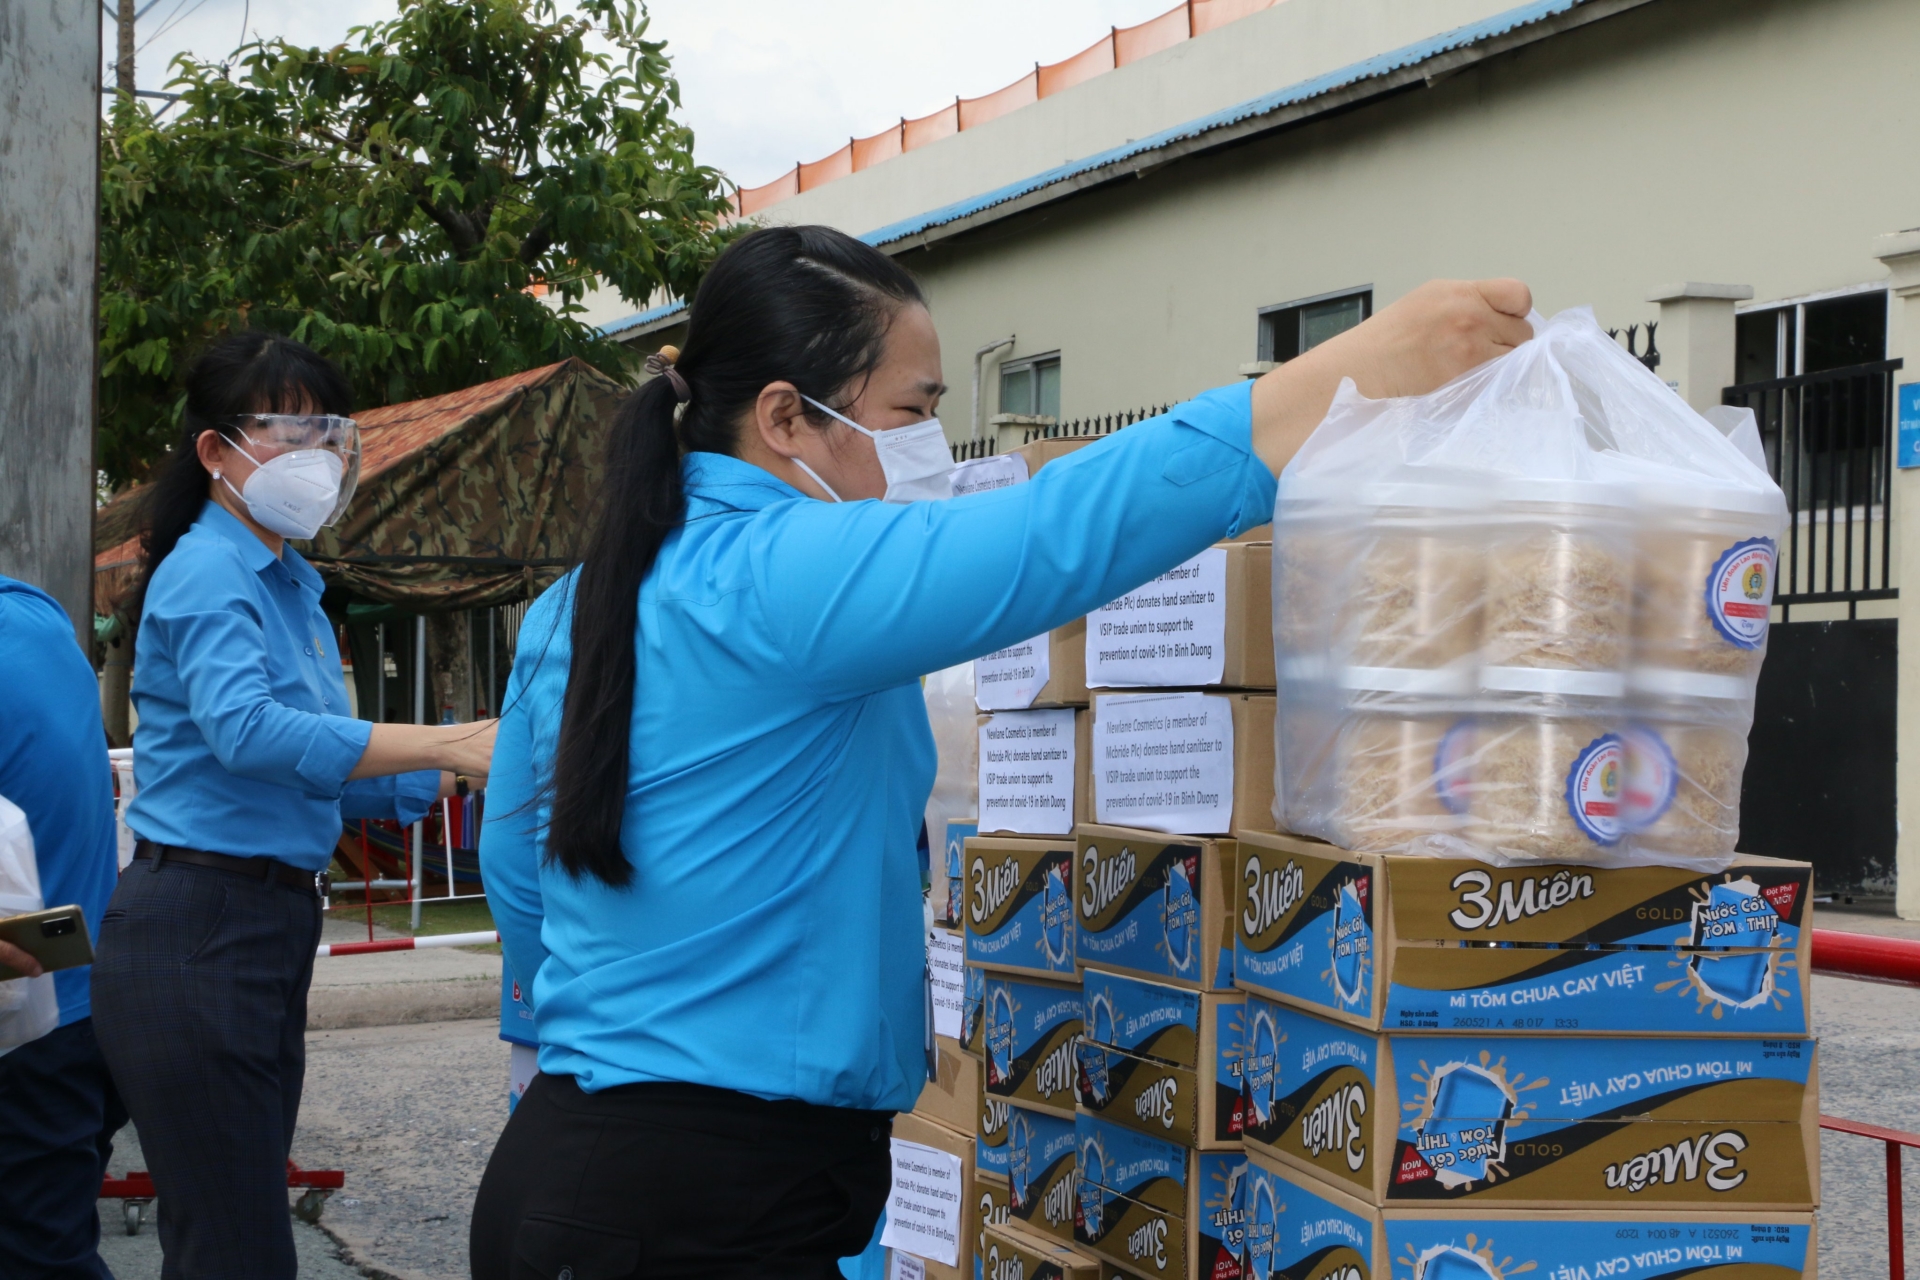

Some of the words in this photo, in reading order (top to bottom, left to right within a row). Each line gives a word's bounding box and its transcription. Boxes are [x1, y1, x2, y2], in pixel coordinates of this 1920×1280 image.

[1192, 564, 1200, 578] of
[1125, 596, 1135, 611] Plc)
[1137, 595, 1160, 608] donates
[1163, 592, 1177, 606] hand
[1180, 590, 1206, 605] sanitizer
[1208, 591, 1215, 603] to
[1100, 622, 1112, 636] VSIP
[1114, 621, 1128, 635] trade
[1130, 620, 1147, 634] union
[1149, 621, 1155, 632] to
[1156, 618, 1181, 636] support
[1183, 617, 1193, 630] the
[1100, 647, 1129, 664] prevention
[1131, 646, 1138, 659] of
[1139, 645, 1165, 658] covid-19
[1167, 645, 1173, 657] in
[1175, 643, 1188, 656] Binh
[1191, 643, 1212, 659] Duong
[987, 728, 1005, 739] Newlane
[1006, 726, 1026, 739] Cosmetics
[1033, 725, 1050, 737] member
[1107, 720, 1131, 734] Newlane
[1133, 717, 1163, 731] Cosmetics
[1172, 713, 1198, 728] member
[1201, 712, 1207, 725] of
[987, 750, 1003, 762] Mcbride
[1013, 749, 1030, 761] donates
[1031, 748, 1042, 760] hand
[1043, 748, 1061, 760] sanitizer
[1106, 744, 1129, 759] Mcbride
[1131, 743, 1142, 759] Plc)
[1144, 743, 1168, 756] donates
[1170, 740, 1185, 754] hand
[1186, 738, 1213, 753] sanitizer
[1215, 739, 1222, 751] to
[986, 773, 995, 784] VSIP
[997, 772, 1007, 784] trade
[1008, 772, 1020, 784] union
[1028, 773, 1045, 787] support
[1106, 770, 1118, 783] VSIP
[1120, 769, 1135, 782] trade
[1137, 768, 1154, 781] union
[1156, 769, 1162, 780] to
[1164, 767, 1188, 784] support
[1189, 765, 1199, 778] the
[987, 795, 1008, 810] prevention
[1015, 795, 1033, 807] covid-19
[1040, 795, 1050, 807] Binh
[1051, 795, 1065, 811] Duong
[1106, 794, 1136, 812] prevention
[1138, 793, 1145, 806] of
[1147, 792, 1172, 805] covid-19
[1174, 792, 1179, 805] in
[1182, 791, 1195, 805] Binh
[1197, 791, 1218, 807] Duong
[1636, 907, 1684, 920] GOLD
[1699, 902, 1737, 924] Nước
[1741, 895, 1766, 912] Cốt
[1703, 921, 1736, 938] TÔM
[1746, 915, 1779, 931] THỊT
[1262, 961, 1277, 975] CHUA
[1278, 954, 1289, 971] CAY
[1450, 995, 1466, 1007] MÌ
[1471, 991, 1506, 1007] TÔM
[1511, 986, 1560, 1004] CHUA
[1563, 975, 1598, 996] CAY
[1602, 964, 1645, 988] VIỆT
[1453, 1018, 1490, 1028] 260521
[1496, 1018, 1504, 1027] A
[1644, 1064, 1692, 1084] CHUA
[1697, 1061, 1732, 1078] TÔM
[1737, 1061, 1753, 1075] MÌ
[1606, 1073, 1641, 1095] CAY
[1560, 1081, 1602, 1107] VIỆT
[1416, 1133, 1449, 1151] THỊT
[1460, 1126, 1495, 1144] TÔM
[1514, 1144, 1563, 1157] GOLD
[1688, 1229, 1697, 1238] A
[1703, 1229, 1739, 1240] 260521
[1633, 1249, 1681, 1268] CHUA
[1686, 1245, 1722, 1262] TÔM
[1727, 1246, 1742, 1260] MÌ
[1595, 1257, 1630, 1278] CAY
